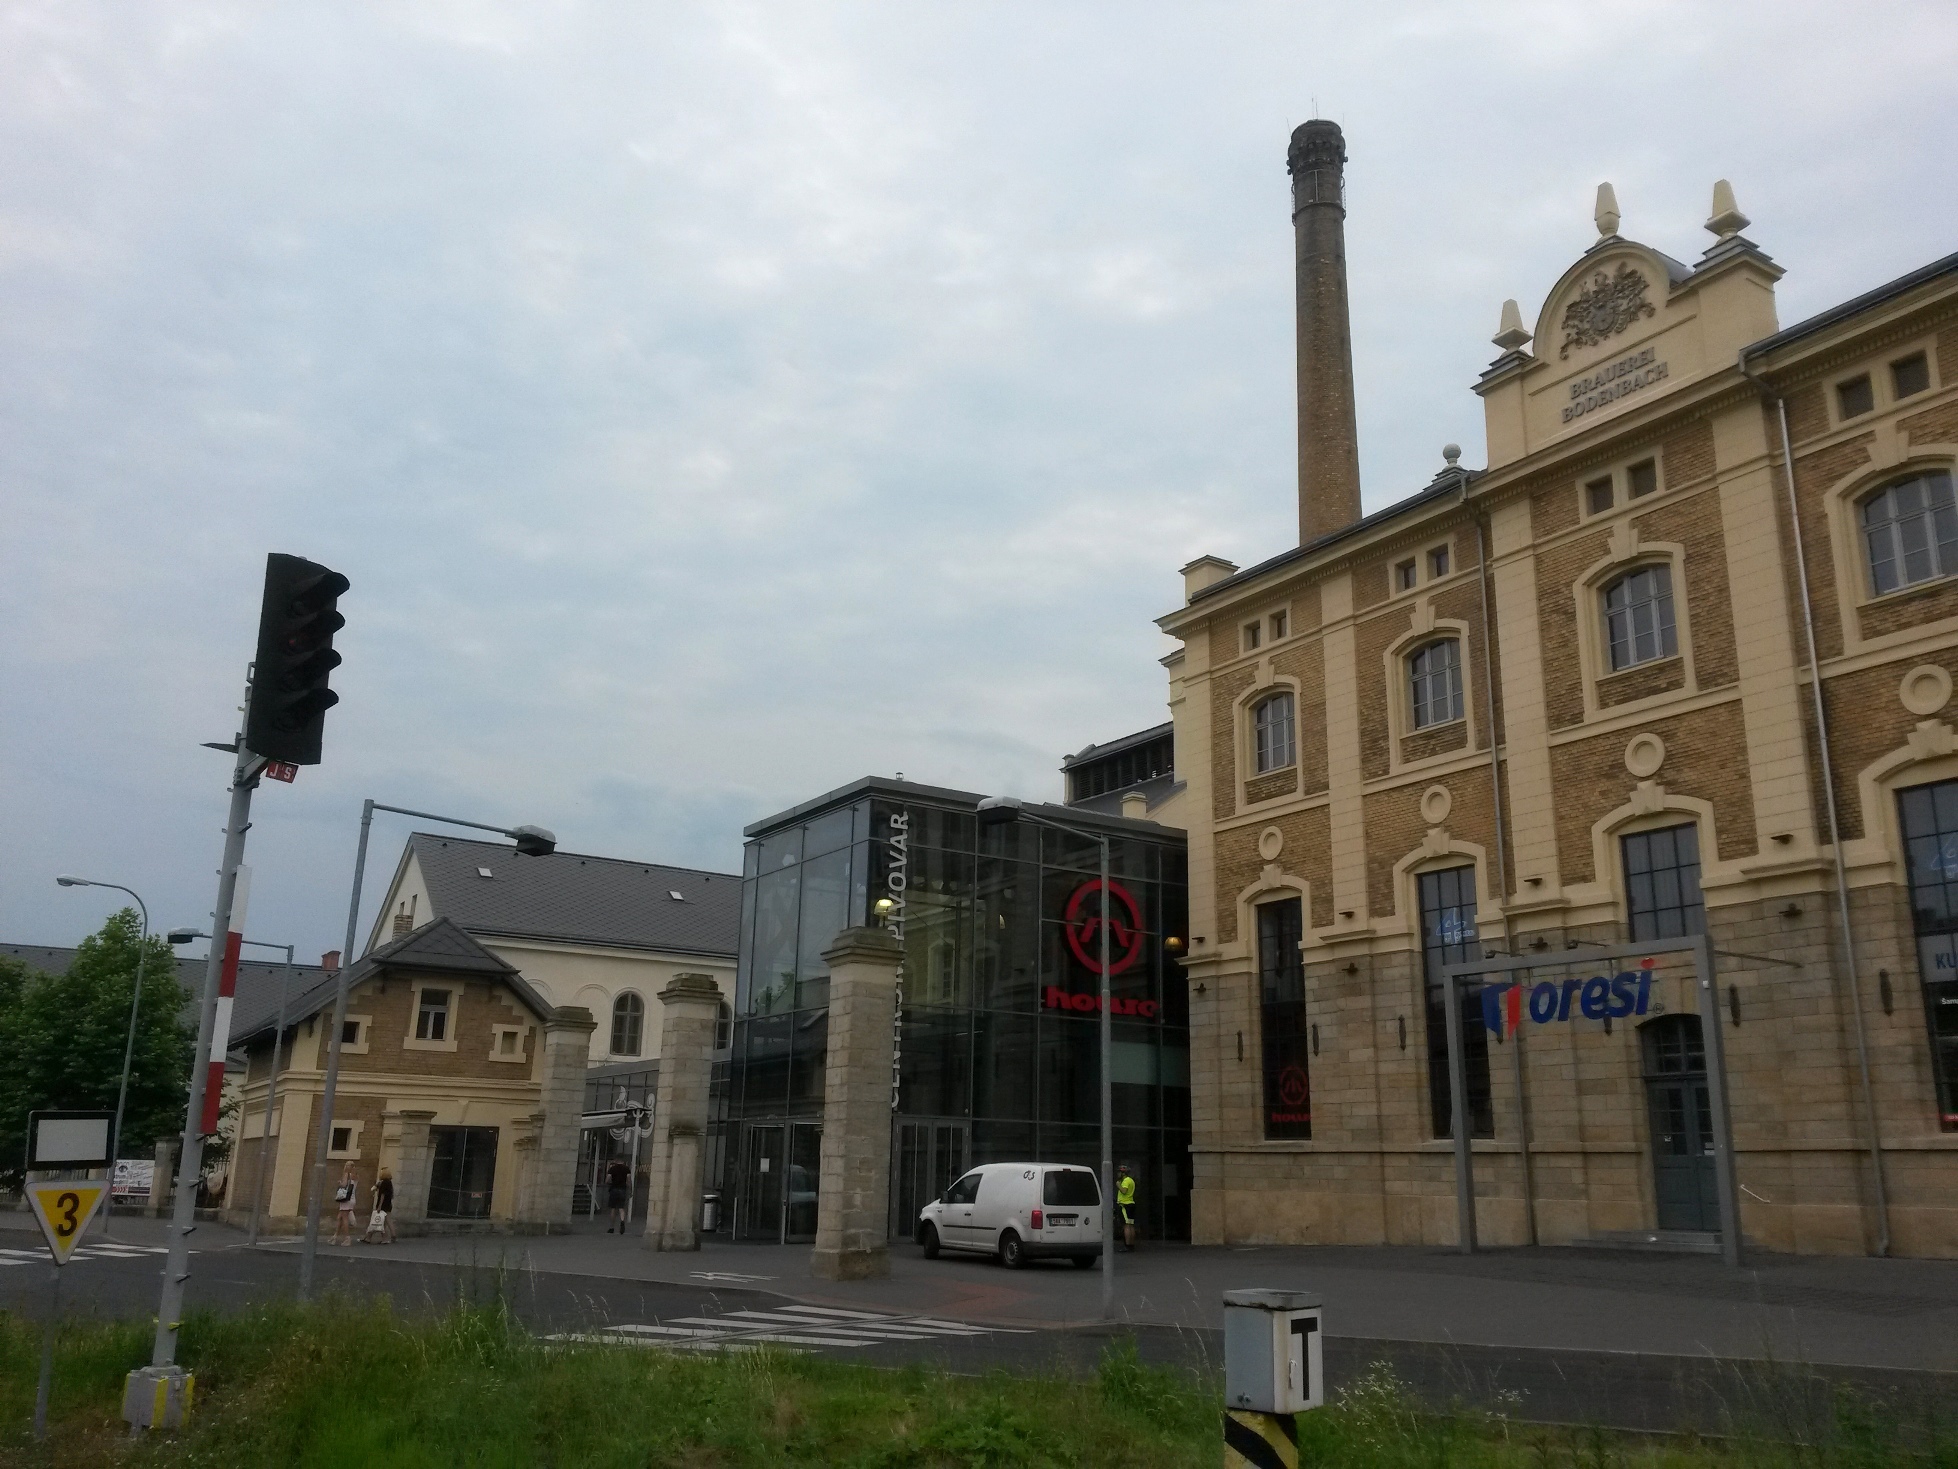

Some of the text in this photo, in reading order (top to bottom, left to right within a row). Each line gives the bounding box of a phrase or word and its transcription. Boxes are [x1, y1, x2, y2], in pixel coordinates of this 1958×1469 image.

[1561, 361, 1669, 424] BODENBACH
[1569, 346, 1656, 400] BRAUEREI
[887, 811, 908, 941] PIVOVAR
[1529, 957, 1655, 1024] oresi
[57, 1192, 80, 1237] 3
[1290, 1316, 1318, 1401] T
